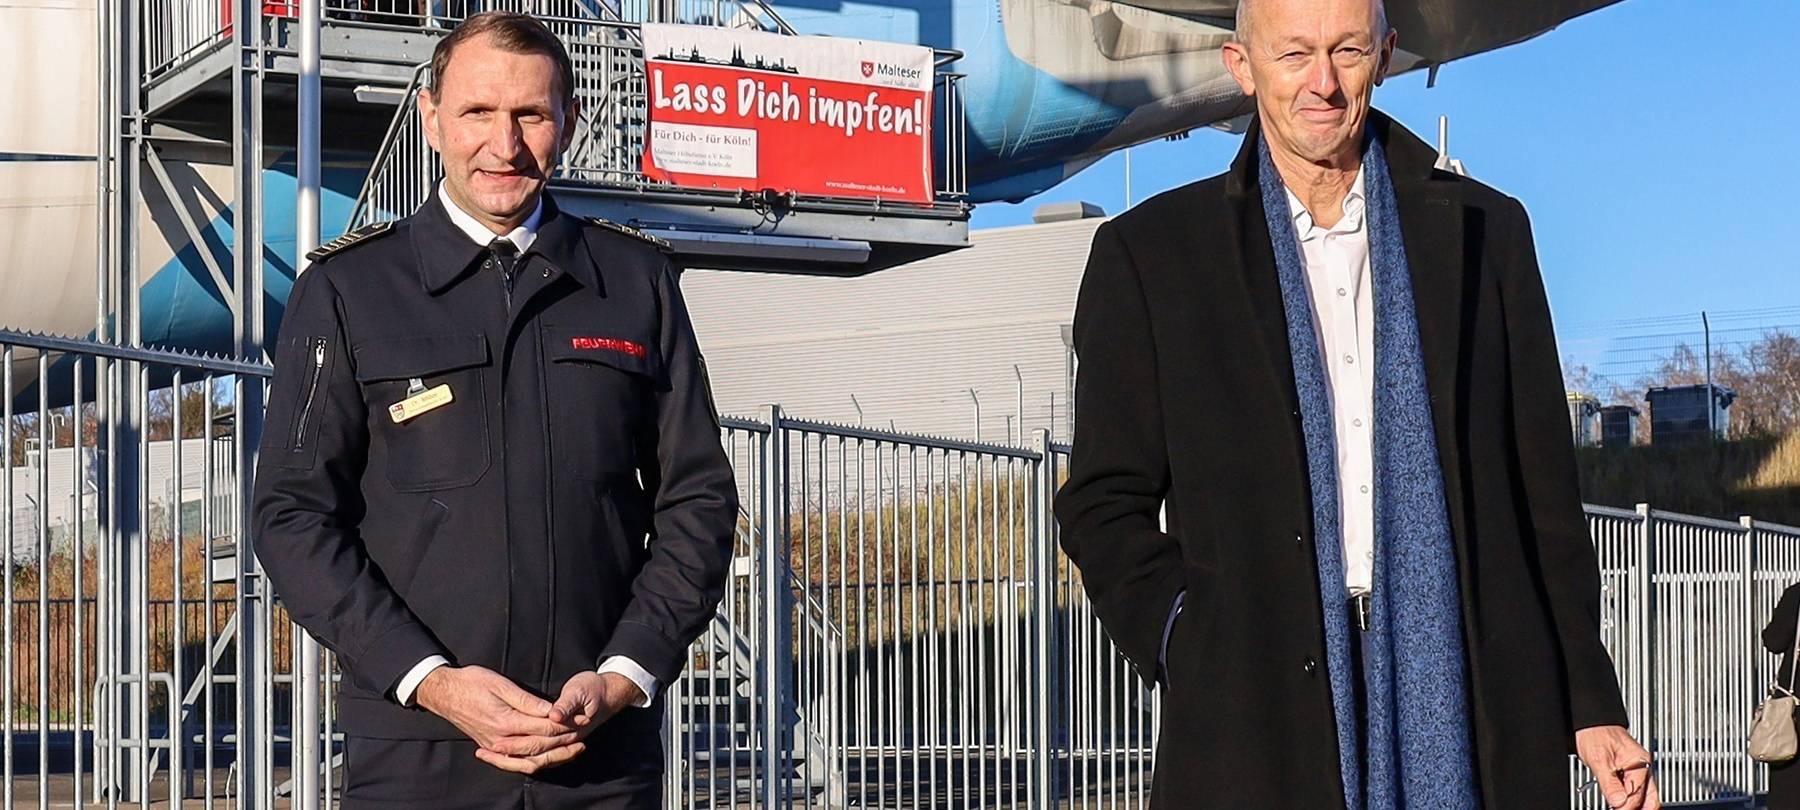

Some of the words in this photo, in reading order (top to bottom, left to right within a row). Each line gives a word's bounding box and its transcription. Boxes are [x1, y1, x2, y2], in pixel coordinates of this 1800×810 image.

[877, 63, 921, 79] Malteser
[653, 68, 727, 115] Lass
[737, 77, 800, 122] Dich
[809, 87, 923, 137] impfen!
[655, 129, 671, 140] Für
[673, 131, 697, 142] Dich
[705, 134, 721, 144] für
[723, 135, 752, 146] Köln!
